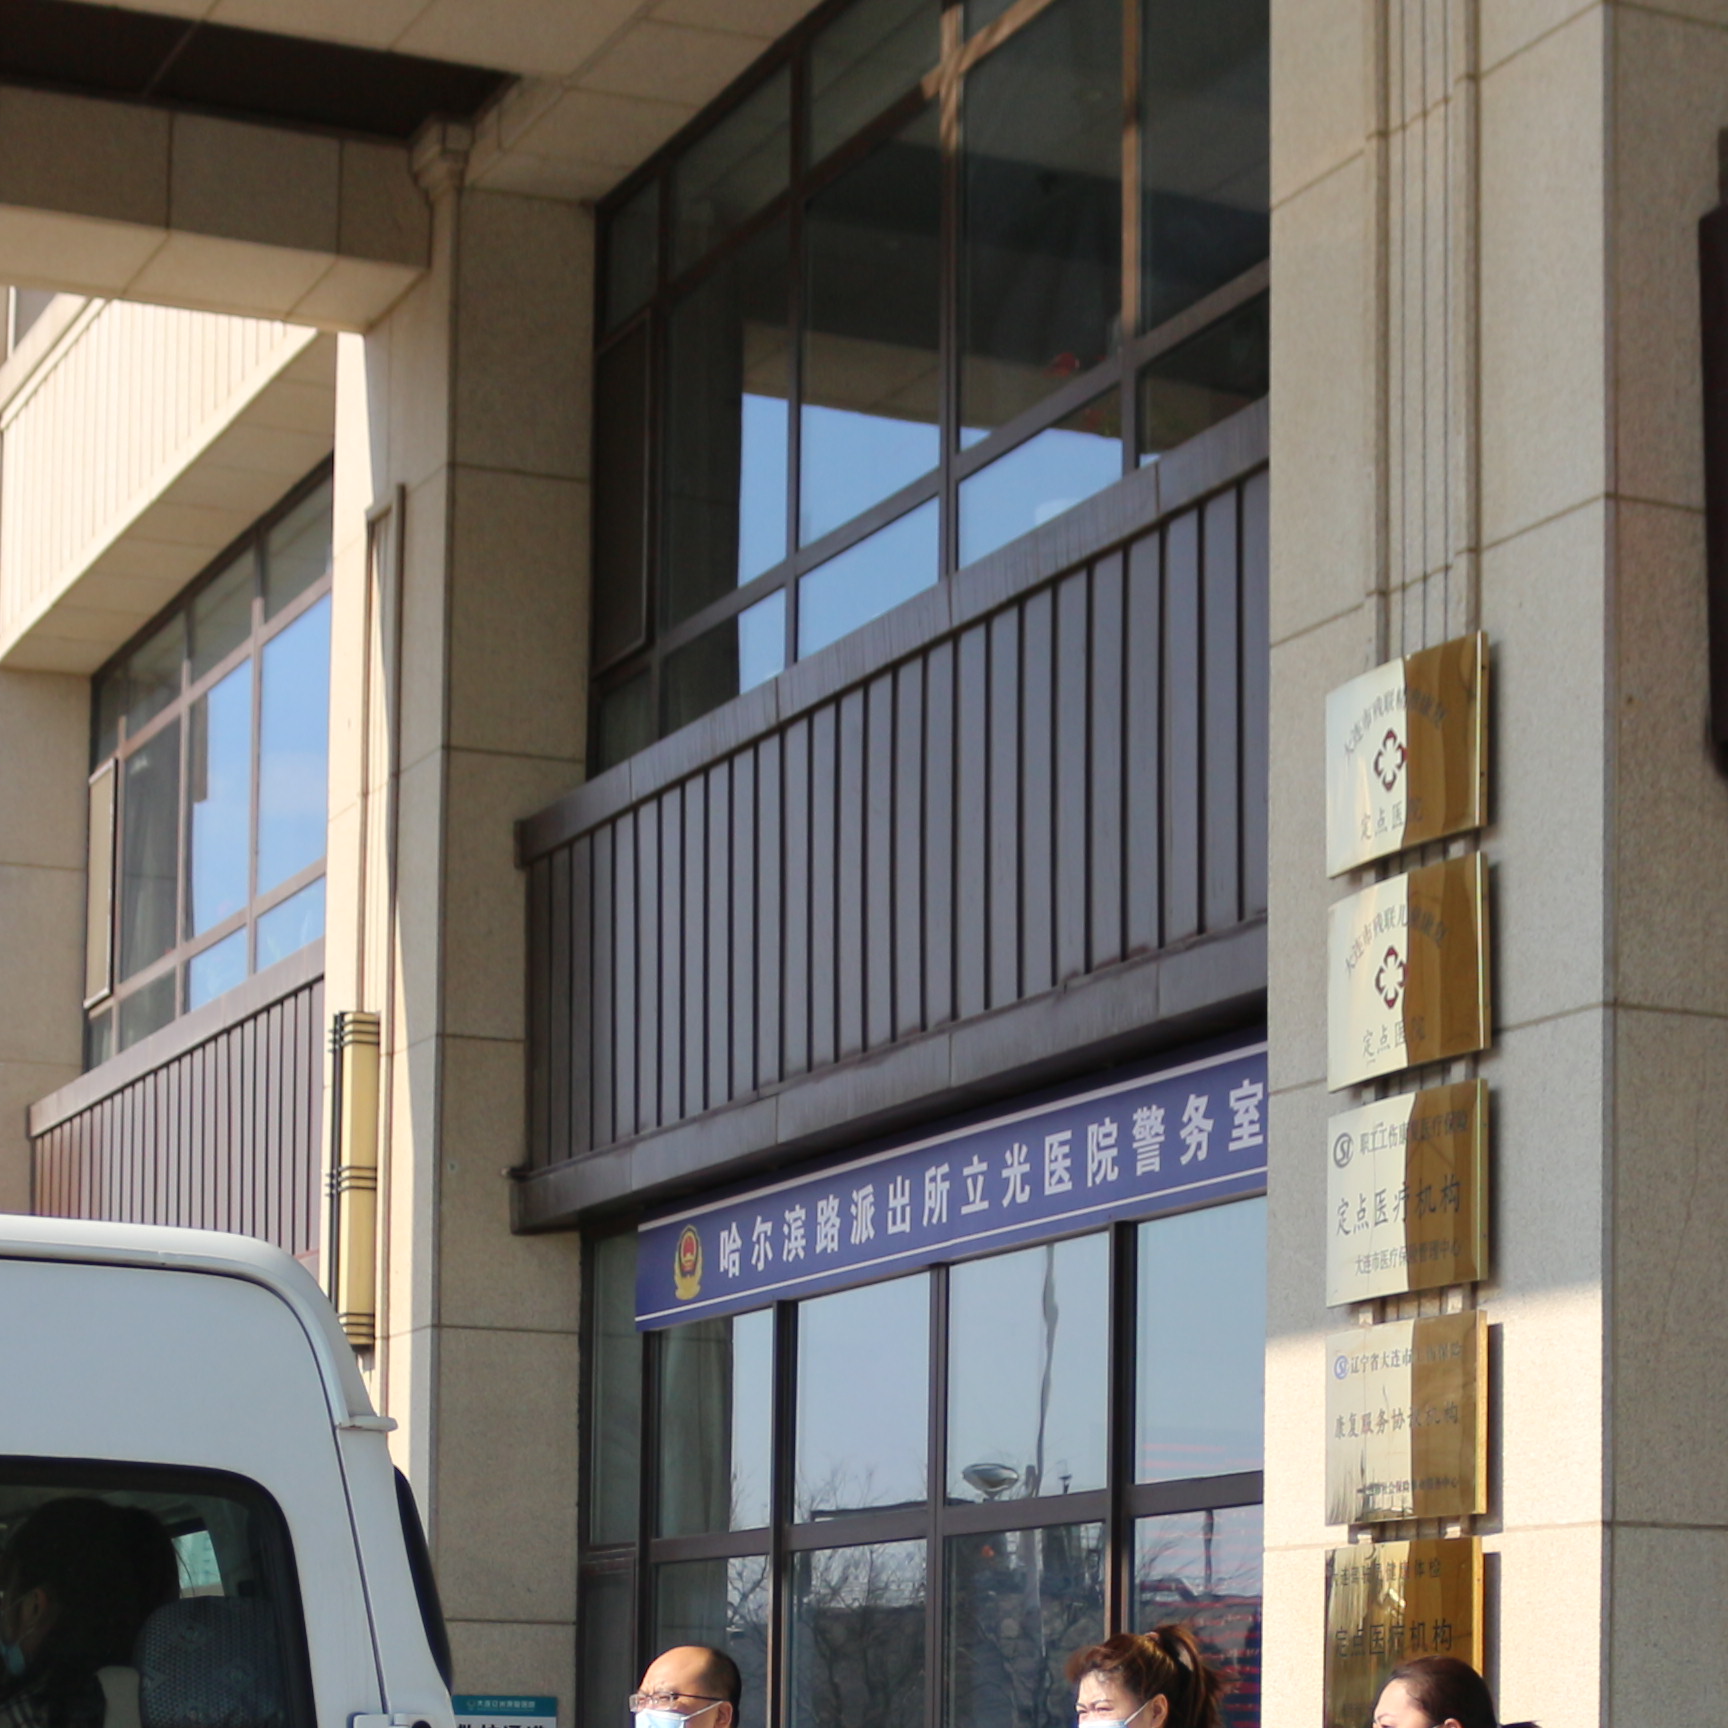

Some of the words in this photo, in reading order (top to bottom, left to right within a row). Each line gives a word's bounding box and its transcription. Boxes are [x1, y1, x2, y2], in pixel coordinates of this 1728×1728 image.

[718, 1079, 1265, 1278] 哈尔滨路派出所立光医院警务室
[1336, 1174, 1461, 1236] 定点医疗机构
[1335, 1401, 1460, 1439] 康复服务协议机构
[1336, 1618, 1453, 1658] 定点医疗机构
